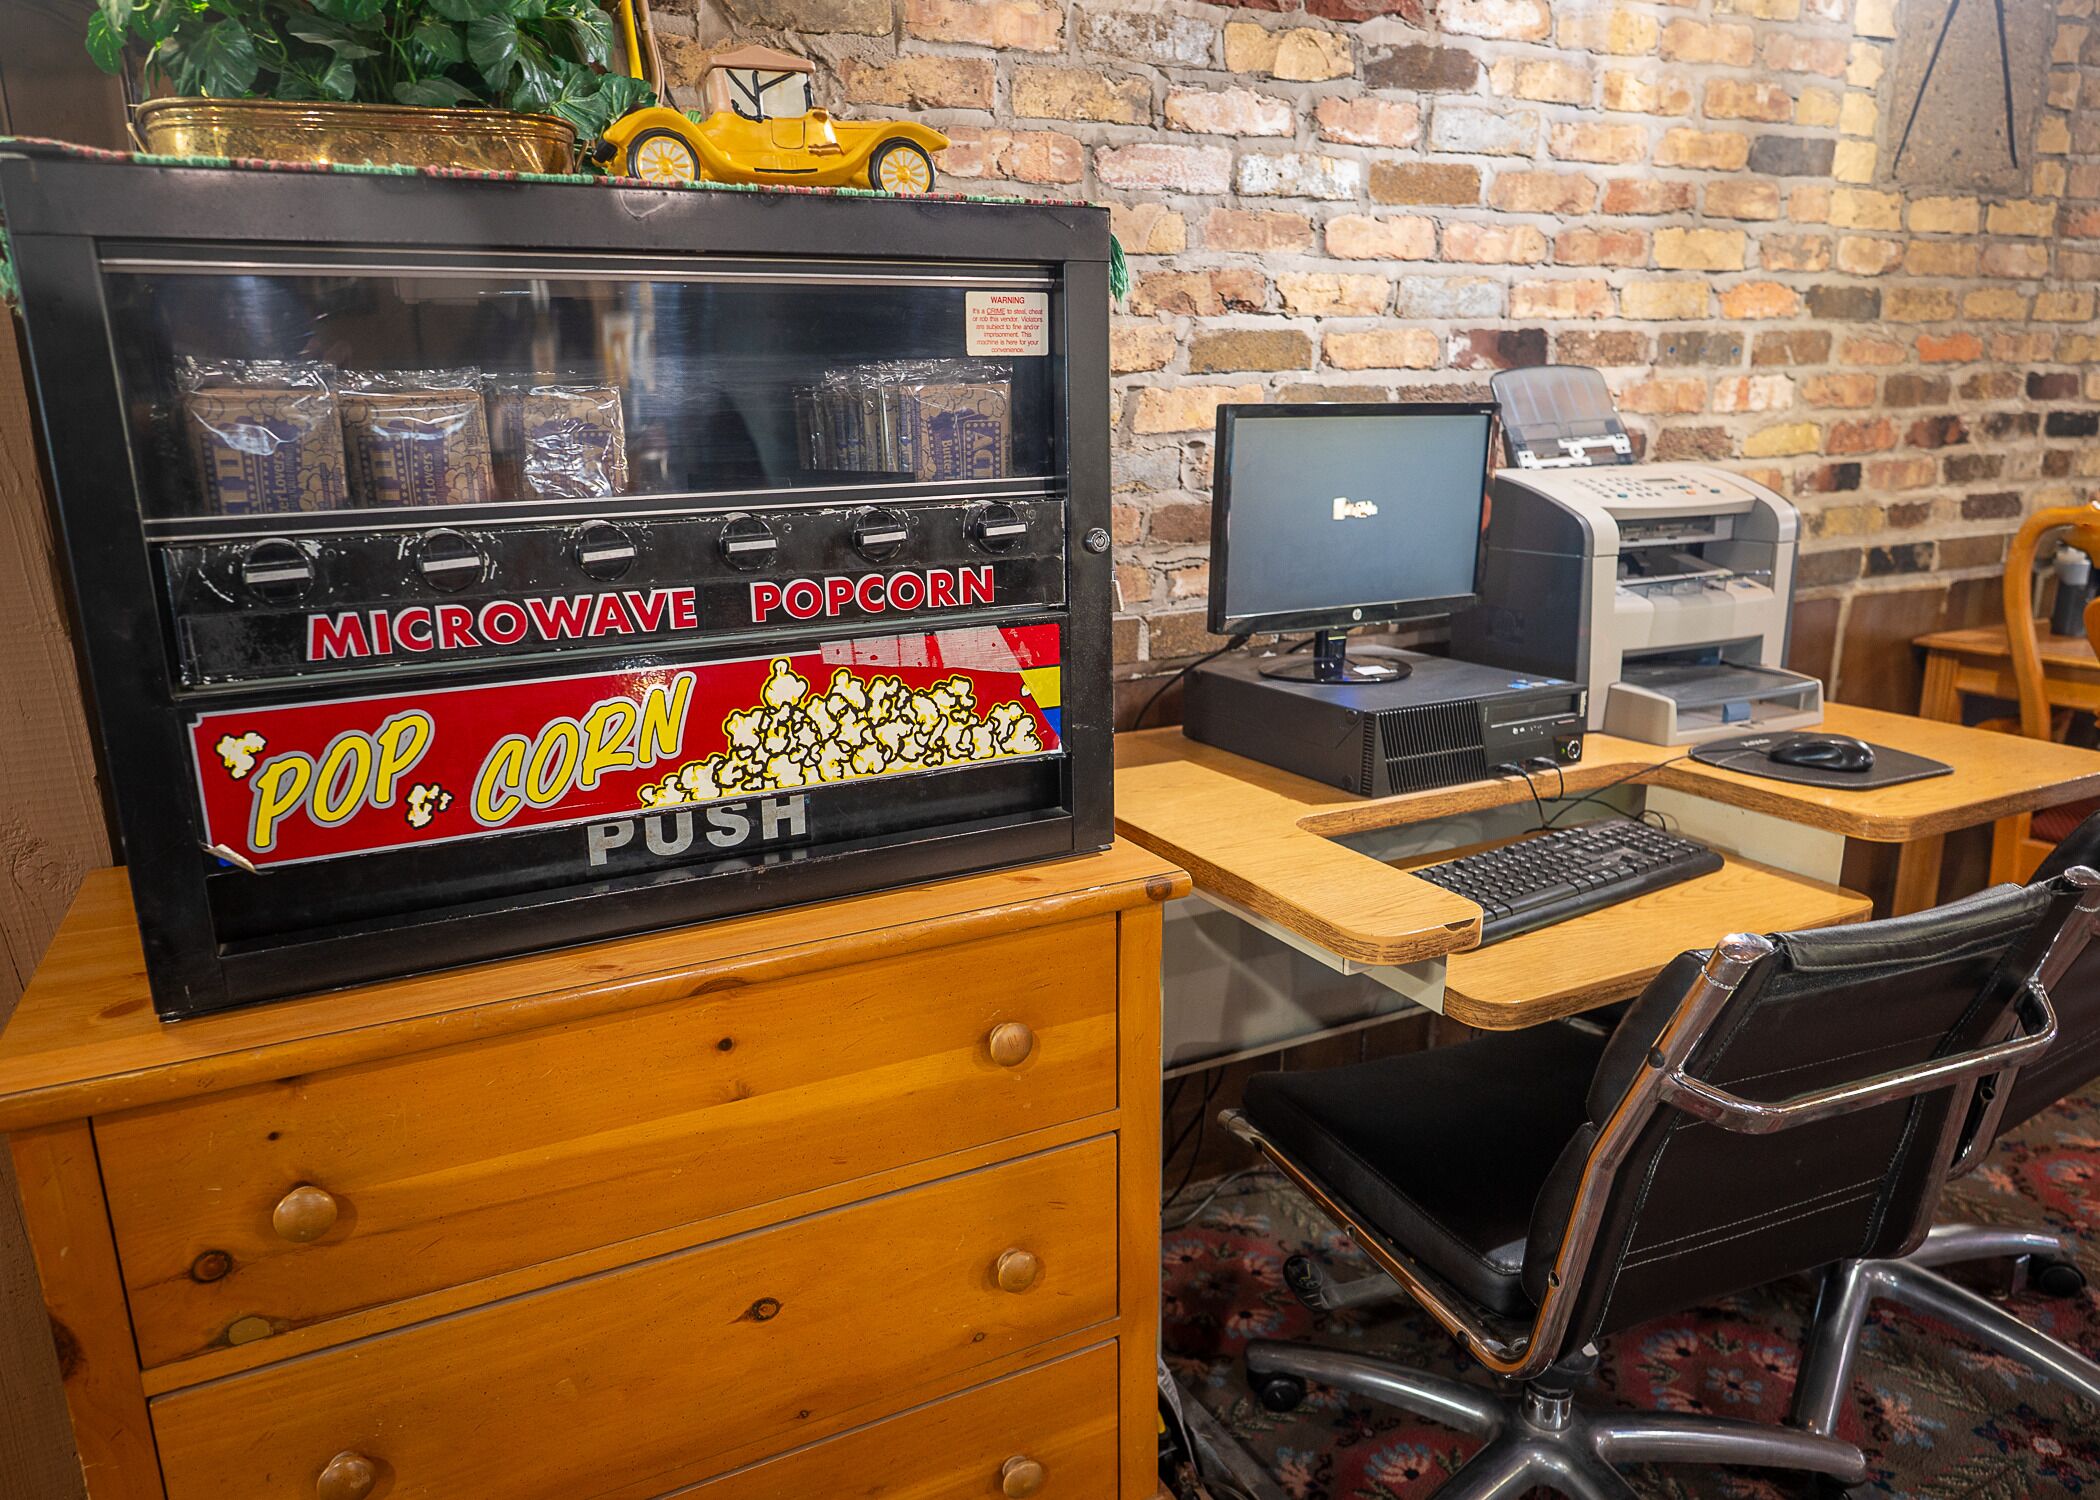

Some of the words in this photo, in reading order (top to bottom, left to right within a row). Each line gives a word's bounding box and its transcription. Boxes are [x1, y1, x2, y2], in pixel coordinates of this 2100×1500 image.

[991, 296, 1025, 304] WARNING
[272, 451, 287, 494] Lovers
[423, 452, 436, 492] Lovers
[941, 439, 953, 474] Butter
[306, 587, 698, 661] MICROWAVE
[749, 565, 995, 624] POPCORN
[247, 709, 436, 854] POP
[470, 670, 698, 828] CORN
[587, 794, 806, 867] PUSH
